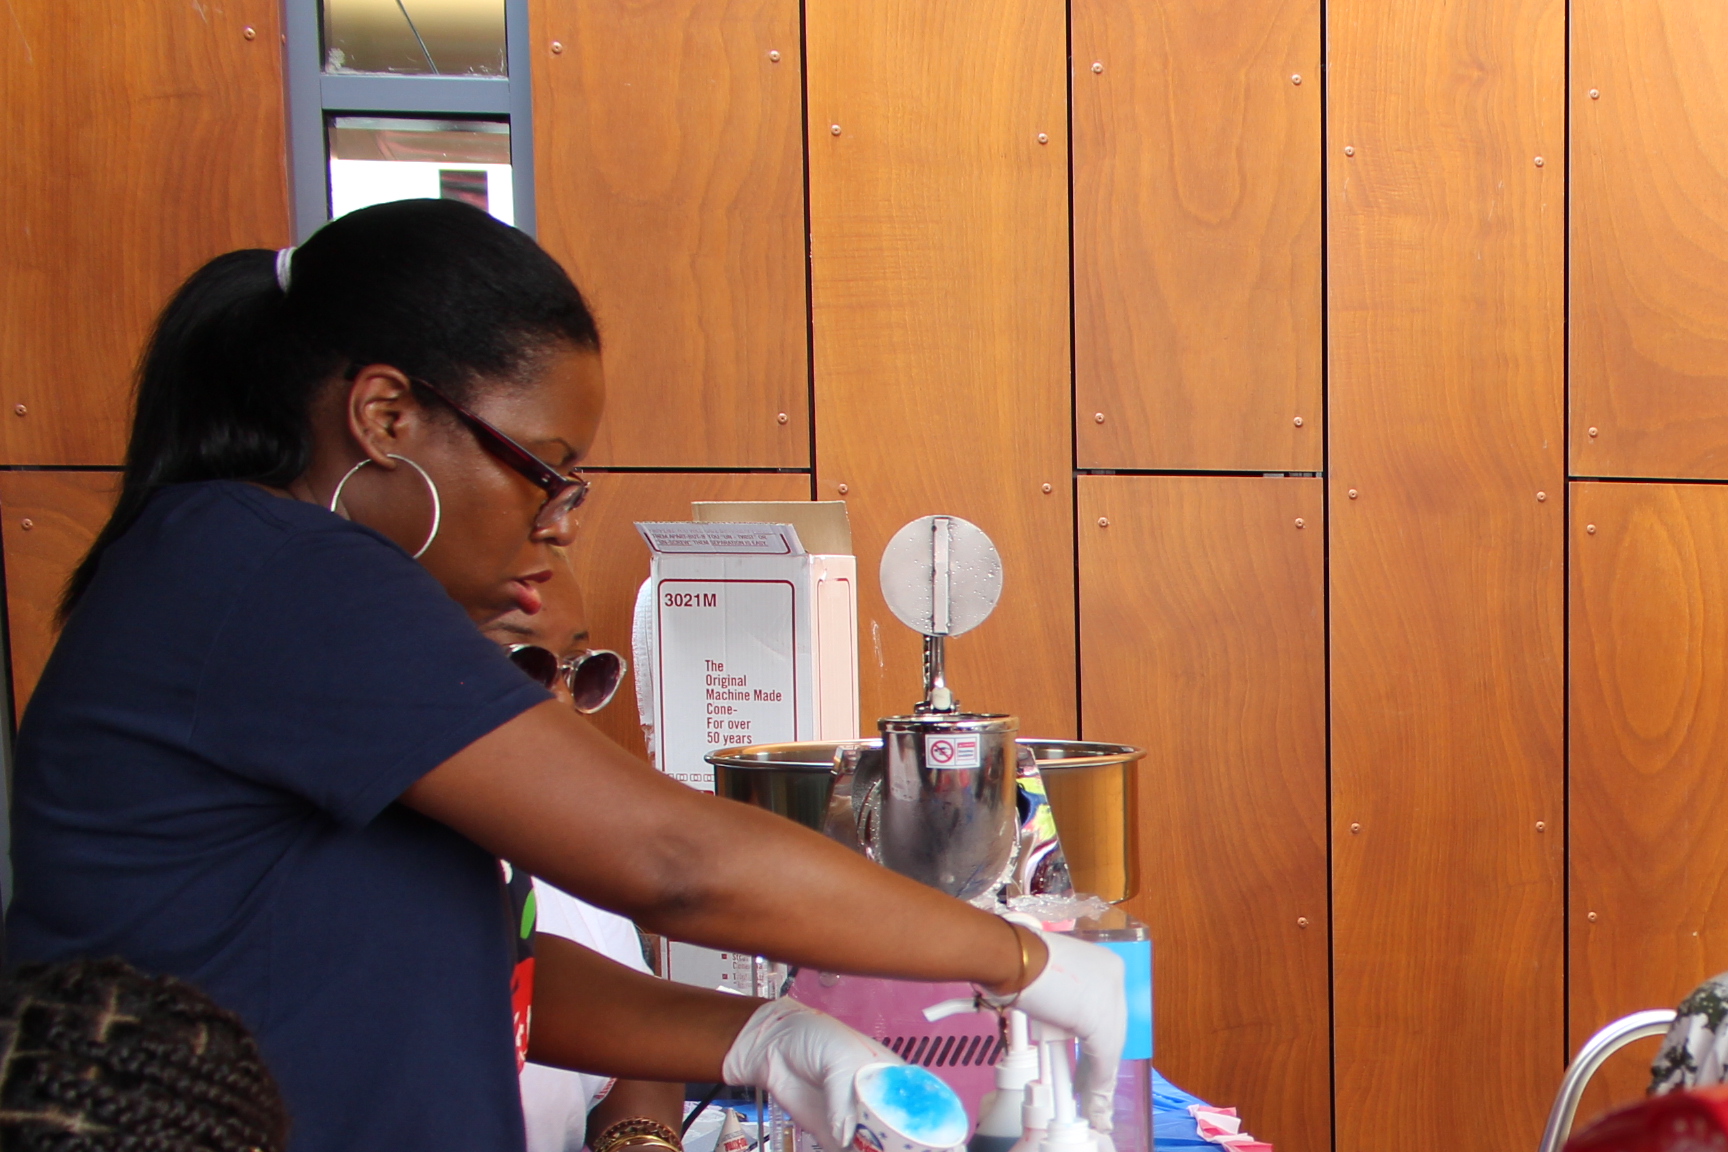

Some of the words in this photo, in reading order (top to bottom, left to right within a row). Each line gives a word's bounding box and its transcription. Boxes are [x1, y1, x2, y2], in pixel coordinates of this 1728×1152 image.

[664, 593, 717, 608] 3021M
[705, 659, 724, 672] The
[705, 674, 747, 689] Original
[706, 688, 750, 701] Machine
[753, 689, 782, 702] Made
[706, 703, 738, 715] Cone-
[706, 717, 724, 730] For
[727, 720, 751, 730] over
[707, 732, 720, 744] 50
[723, 733, 752, 746] years
